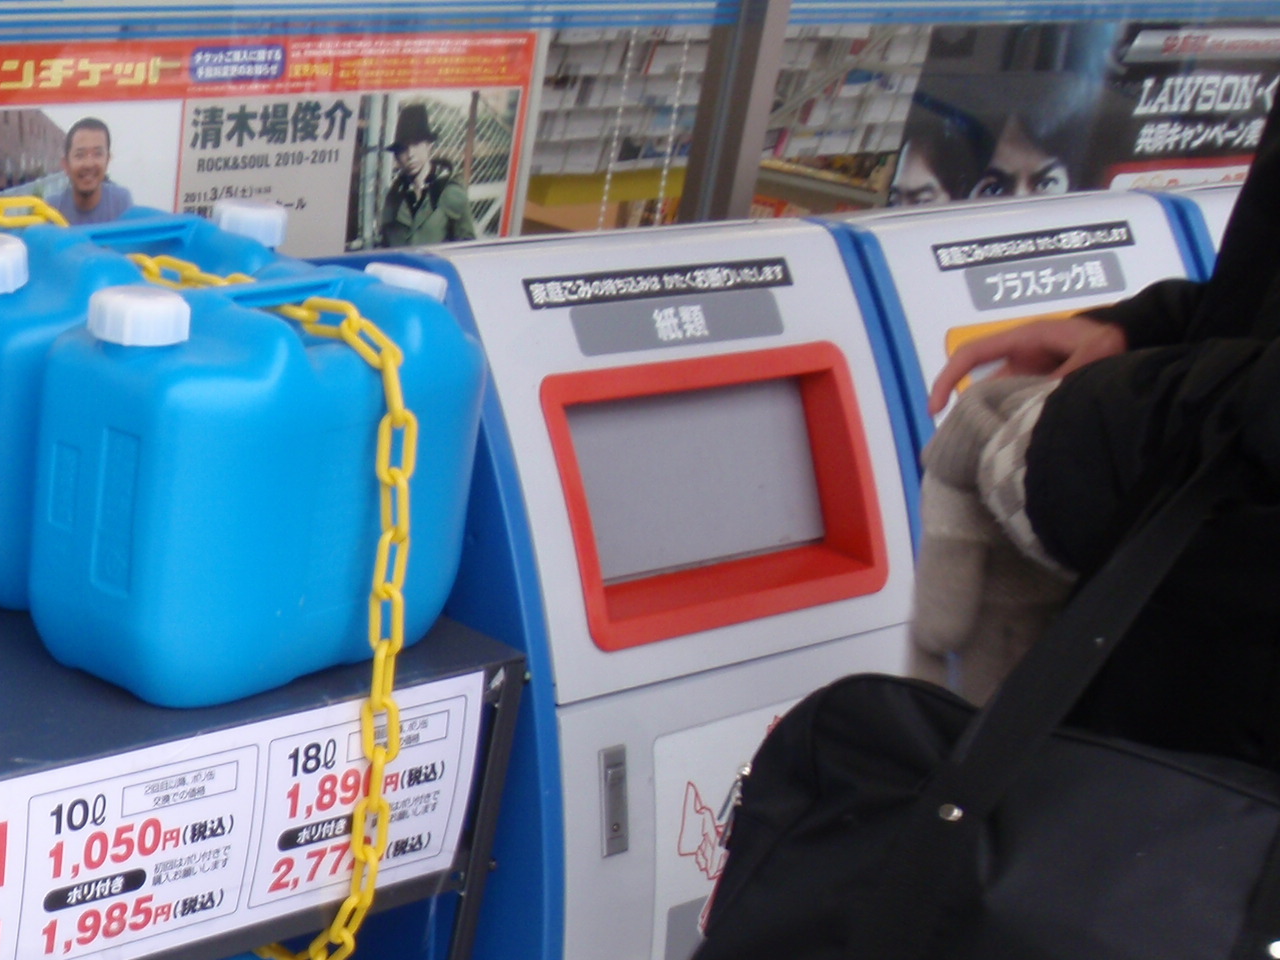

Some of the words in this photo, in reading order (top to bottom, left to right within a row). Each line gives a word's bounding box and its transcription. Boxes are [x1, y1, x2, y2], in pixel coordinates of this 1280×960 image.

[190, 99, 353, 149] 清木場俊介
[197, 154, 270, 173] ROCK&SOUL
[275, 149, 339, 167] 2010-2011
[985, 261, 1108, 302] プラスチック類
[652, 305, 709, 341] 紙類
[296, 818, 347, 844] ポリ付き
[67, 876, 126, 905] ポリ付き
